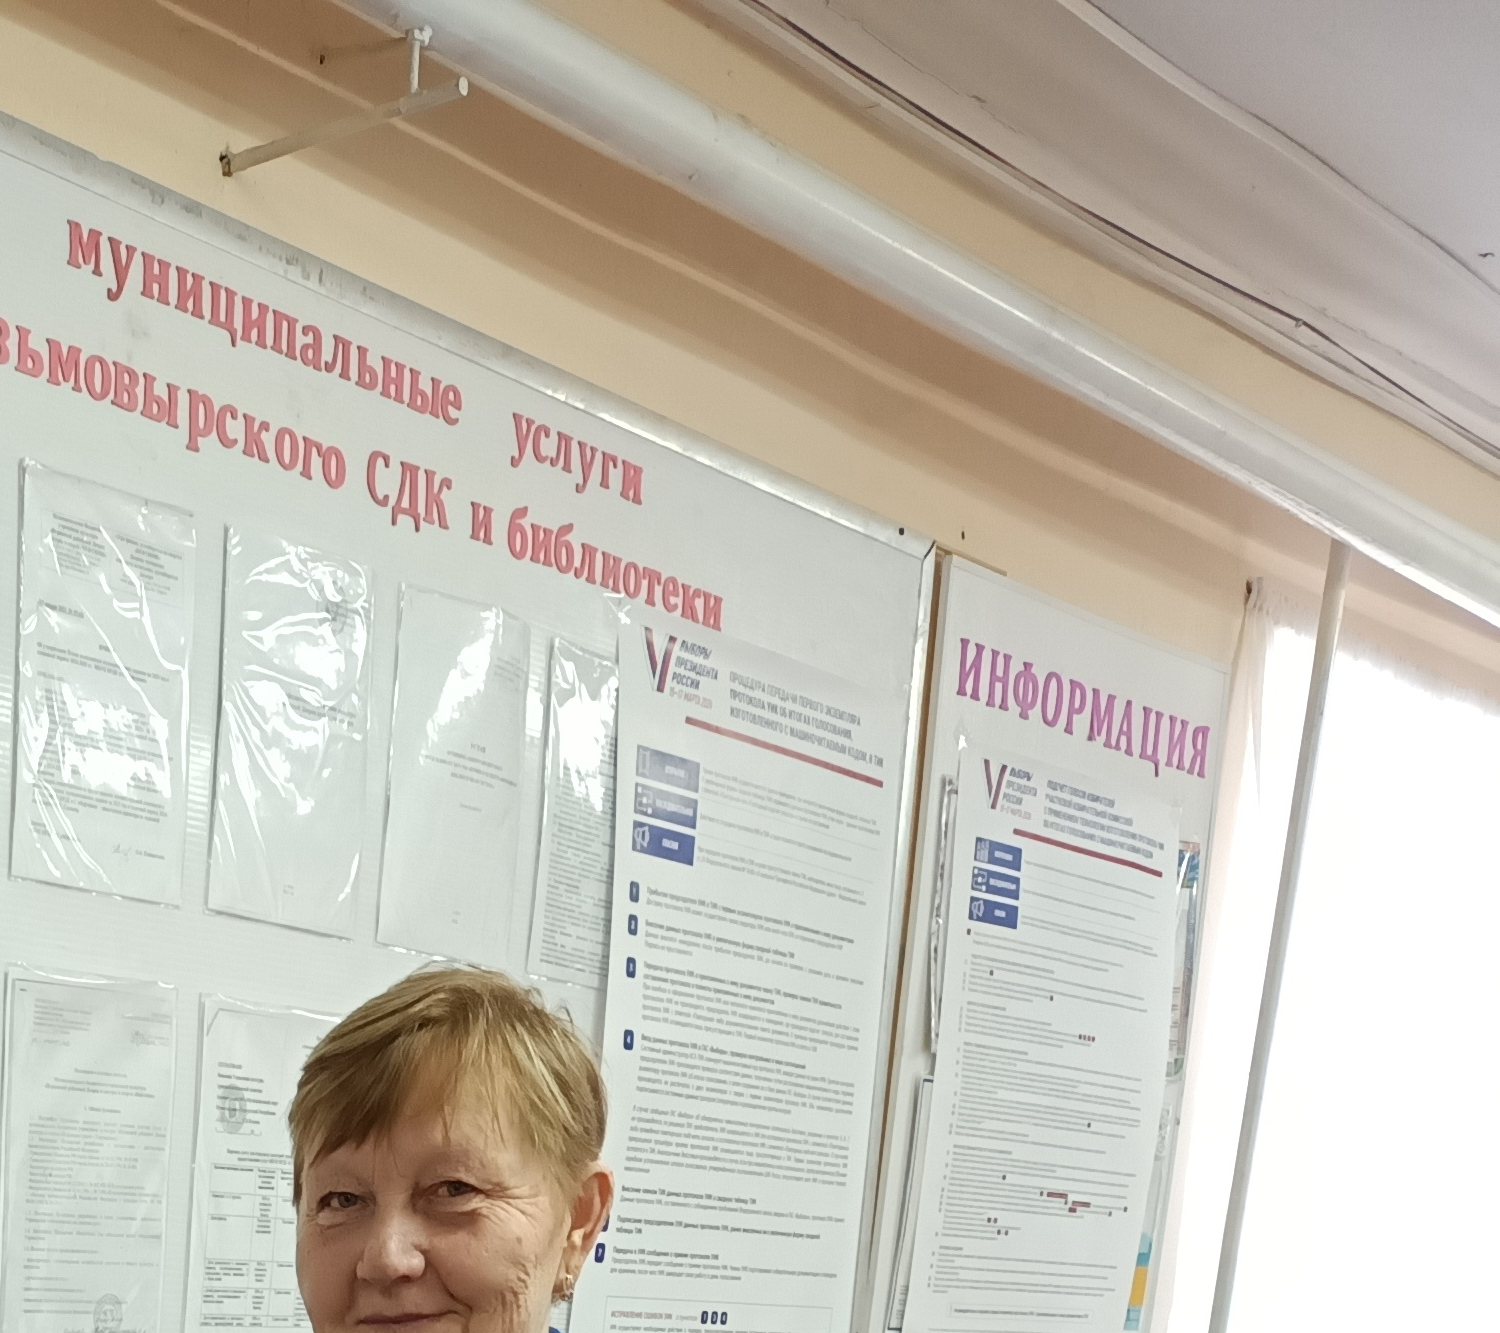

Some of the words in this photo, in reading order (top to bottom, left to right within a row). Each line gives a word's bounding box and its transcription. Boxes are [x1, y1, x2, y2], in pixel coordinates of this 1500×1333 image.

[66, 218, 463, 427] муниципальные
[510, 412, 644, 507] услуги
[366, 448, 453, 533] СДК
[468, 499, 494, 548] и
[507, 504, 725, 633] библиотеки
[674, 656, 719, 682] ПРЕЗИДЕНТА
[678, 639, 713, 661] ВЫБОРЫ
[671, 671, 701, 691] РОССИИ
[729, 671, 766, 695] ПРОЦЕДУРА
[799, 693, 824, 715] ПЕРВОГО
[729, 688, 766, 712] ПРОТОКОЛА
[788, 708, 811, 727] ИТОГАХ
[956, 637, 1212, 779] ИНФОРМАЦИЯ
[730, 705, 784, 735] ИЗГОТОВЛЕННОГО
[790, 726, 848, 756] МАШИНОЧИТАЕМЫМ
